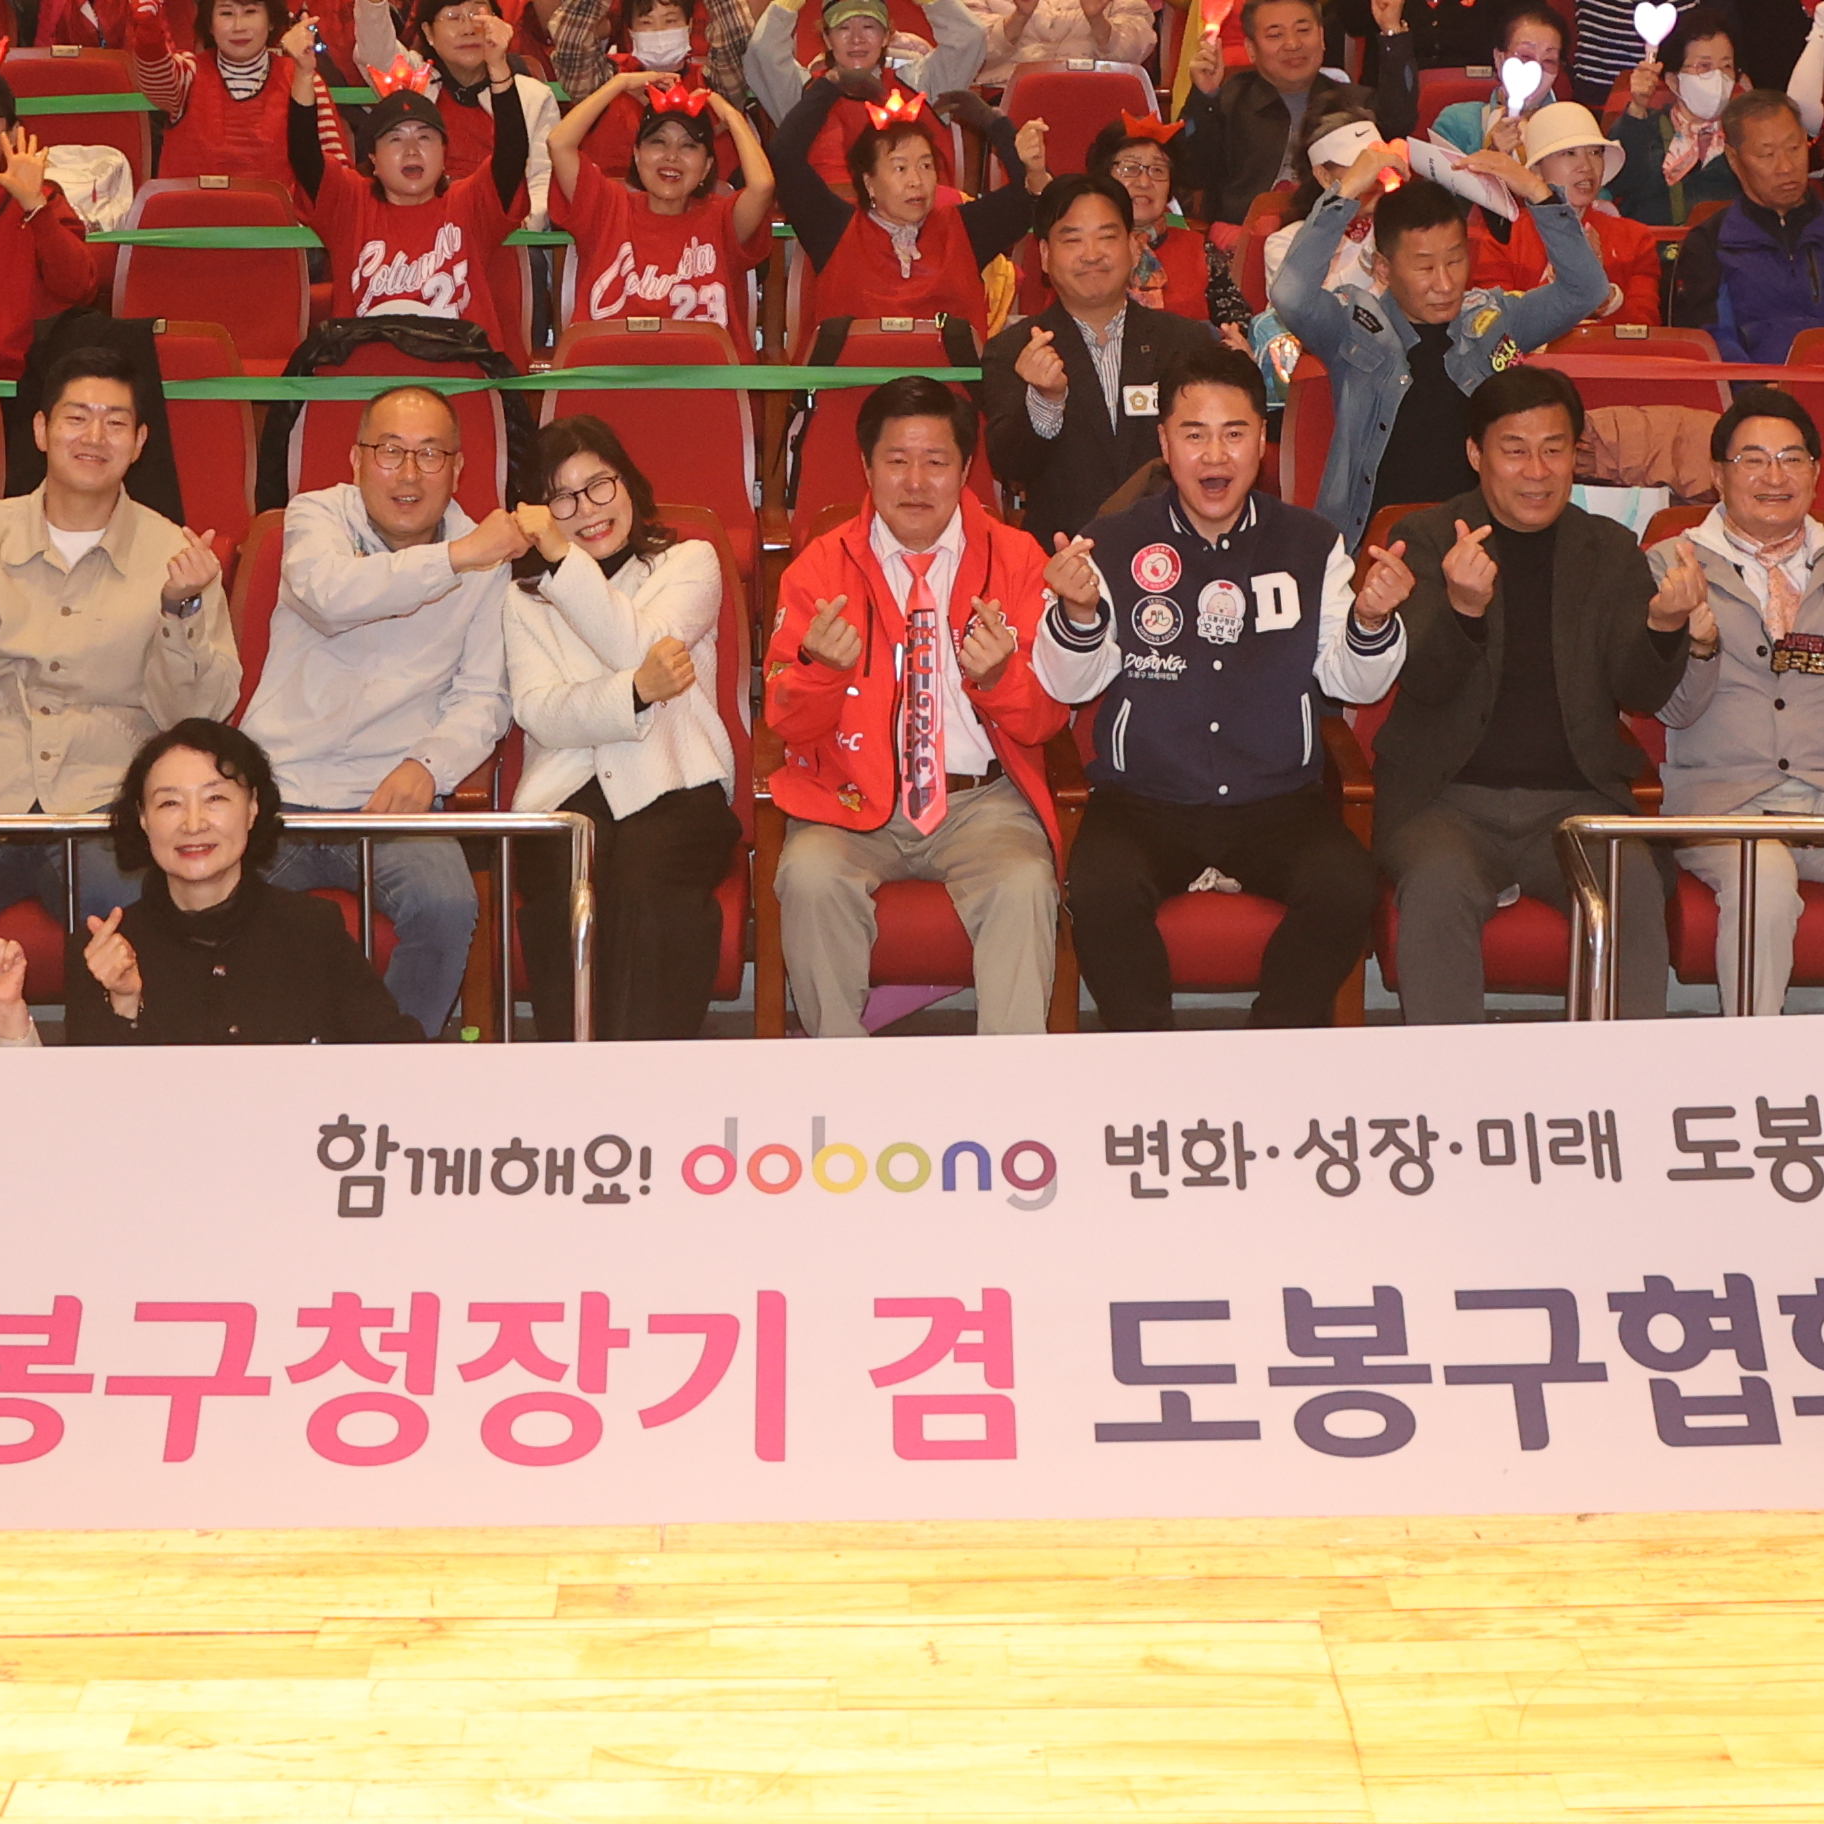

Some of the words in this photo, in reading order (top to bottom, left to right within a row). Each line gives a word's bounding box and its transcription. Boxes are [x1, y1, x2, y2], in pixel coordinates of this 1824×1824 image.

[669, 281, 729, 329] 23
[1202, 622, 1237, 640] 오언석
[1250, 571, 1302, 634] D
[314, 1115, 653, 1217] 함께해요!
[680, 1115, 1059, 1212] dobong
[864, 1284, 1019, 1463] 겸
